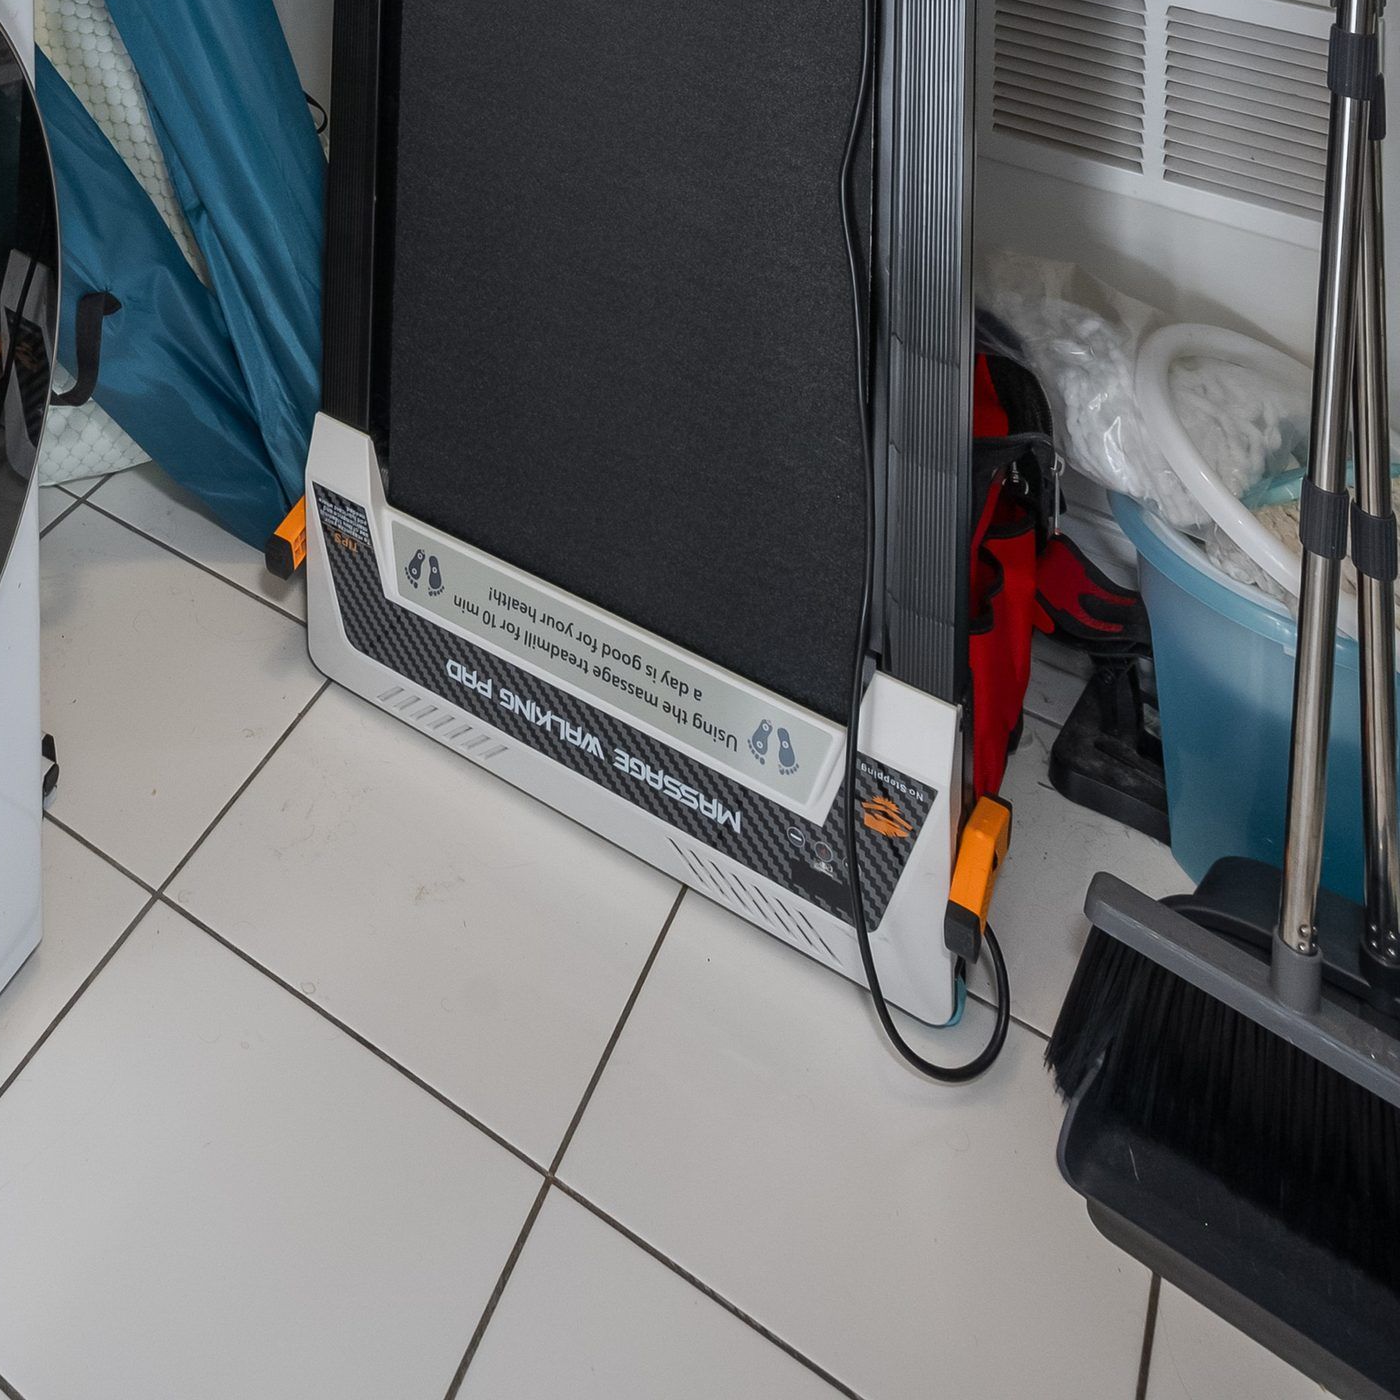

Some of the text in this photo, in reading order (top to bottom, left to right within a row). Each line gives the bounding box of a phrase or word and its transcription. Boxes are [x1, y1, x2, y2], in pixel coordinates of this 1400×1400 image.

[333, 531, 359, 553] TIPS
[452, 594, 738, 752] Using the massage treadmill for 10 min
[488, 586, 703, 701] a day is good for your health!
[445, 657, 742, 834] MASSAGE WALKING PAD
